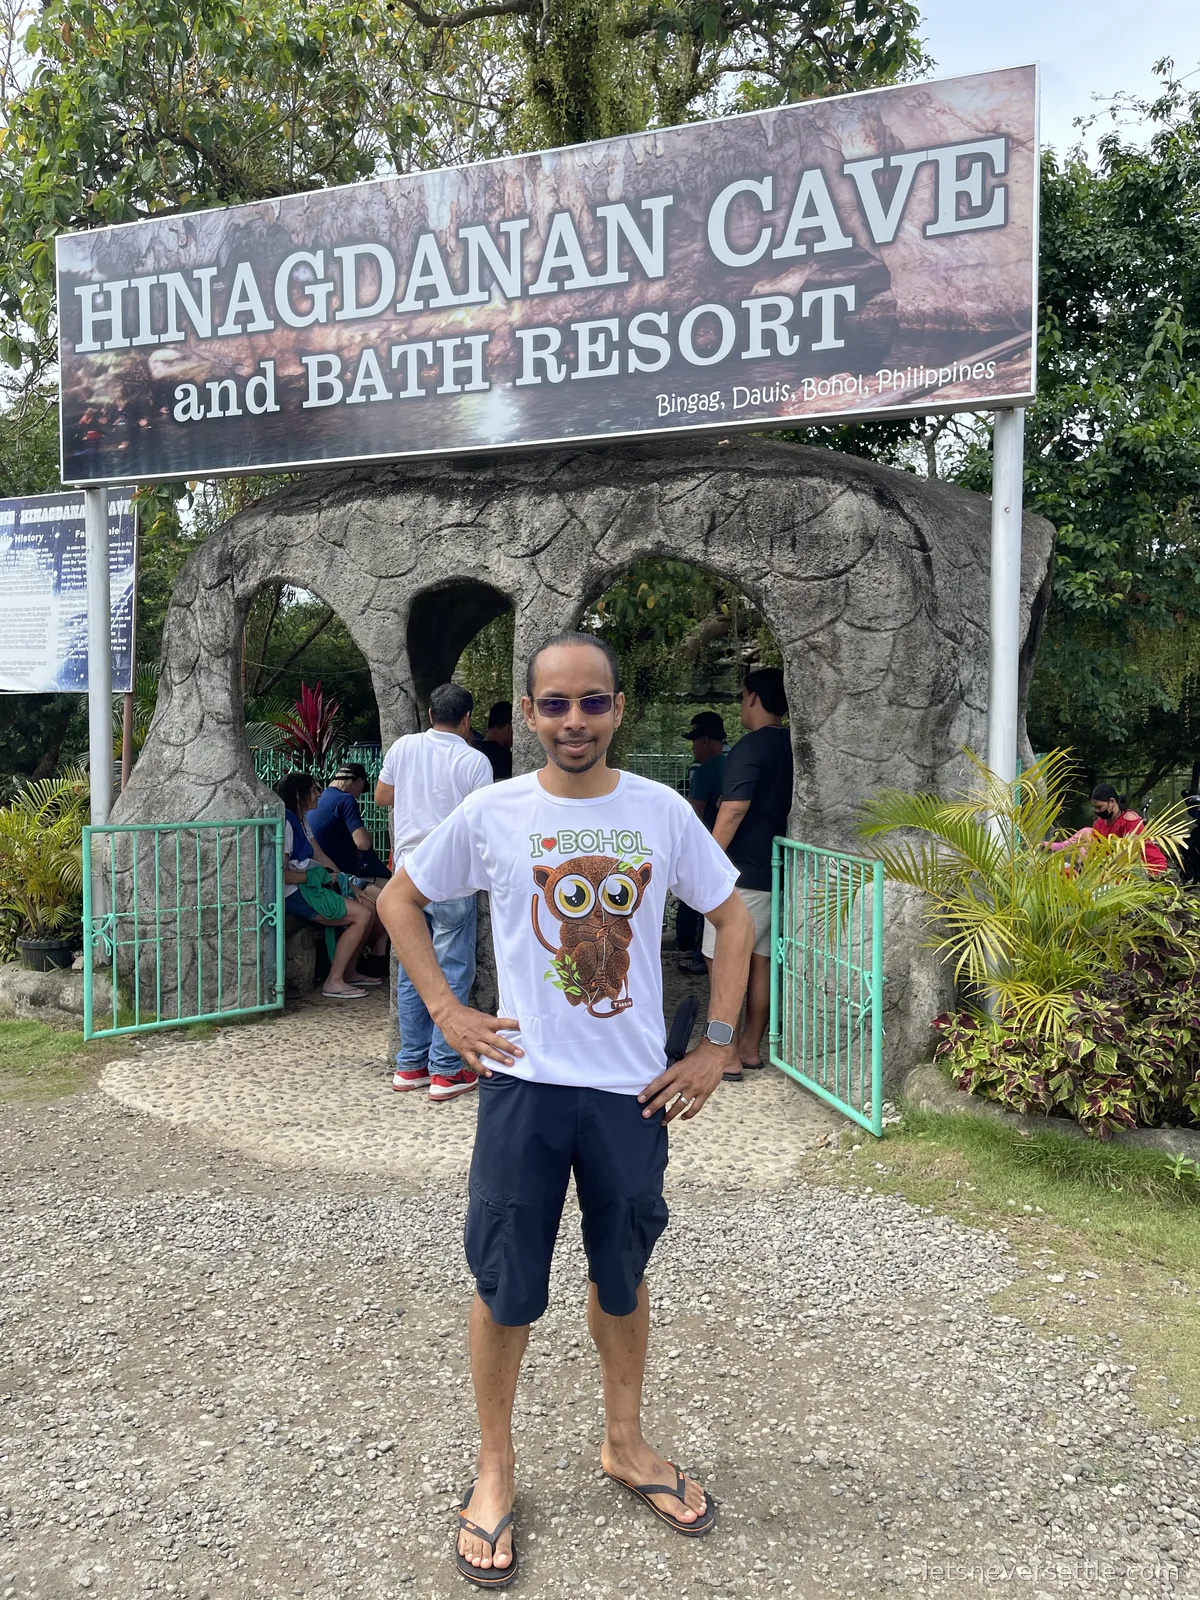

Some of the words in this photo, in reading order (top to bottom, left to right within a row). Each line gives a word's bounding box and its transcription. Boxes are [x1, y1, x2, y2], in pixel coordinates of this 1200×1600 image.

[74, 194, 673, 353] HINAGDANAN
[706, 137, 1007, 268] CAVE
[173, 361, 280, 422] and
[302, 333, 490, 409] BATH
[515, 285, 856, 386] RESORT
[655, 390, 726, 418] Bingag,
[732, 380, 796, 408] Dauis,
[801, 373, 869, 402] Bohol,
[875, 360, 997, 393] Philippines
[20, 504, 85, 524] HINAGDANA
[108, 500, 131, 516] AVE
[15, 534, 44, 543] History
[529, 833, 543, 858] I
[557, 829, 653, 855] BOHOL
